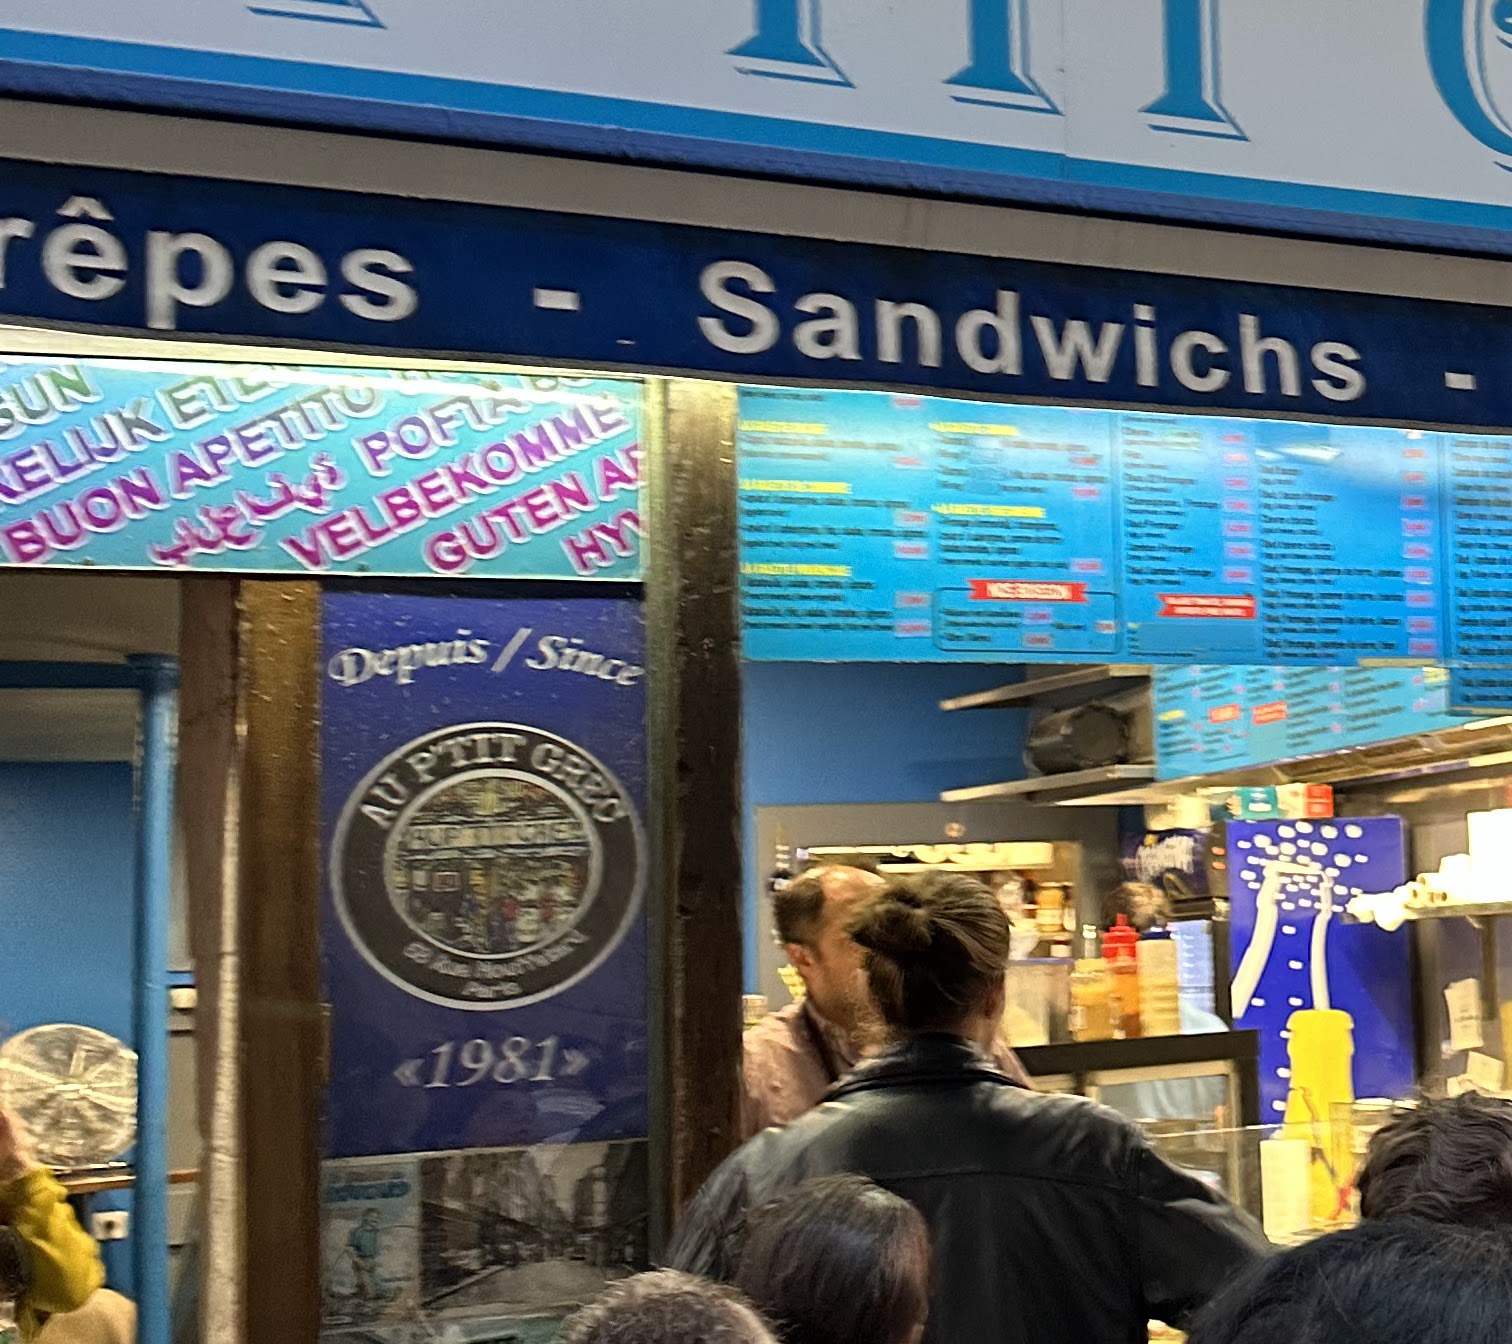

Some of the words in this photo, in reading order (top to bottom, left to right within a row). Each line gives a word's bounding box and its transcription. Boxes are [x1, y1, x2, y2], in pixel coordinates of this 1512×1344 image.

[697, 260, 1366, 402] Sandwichs
[2, 467, 170, 564] BUON
[279, 400, 634, 570] VELBEKOMME
[422, 472, 600, 574] GUTEN
[328, 629, 491, 687] Depuis
[525, 635, 645, 686] Since
[359, 771, 409, 830] AU
[405, 732, 528, 785] P'TIT
[531, 742, 632, 824] GREC
